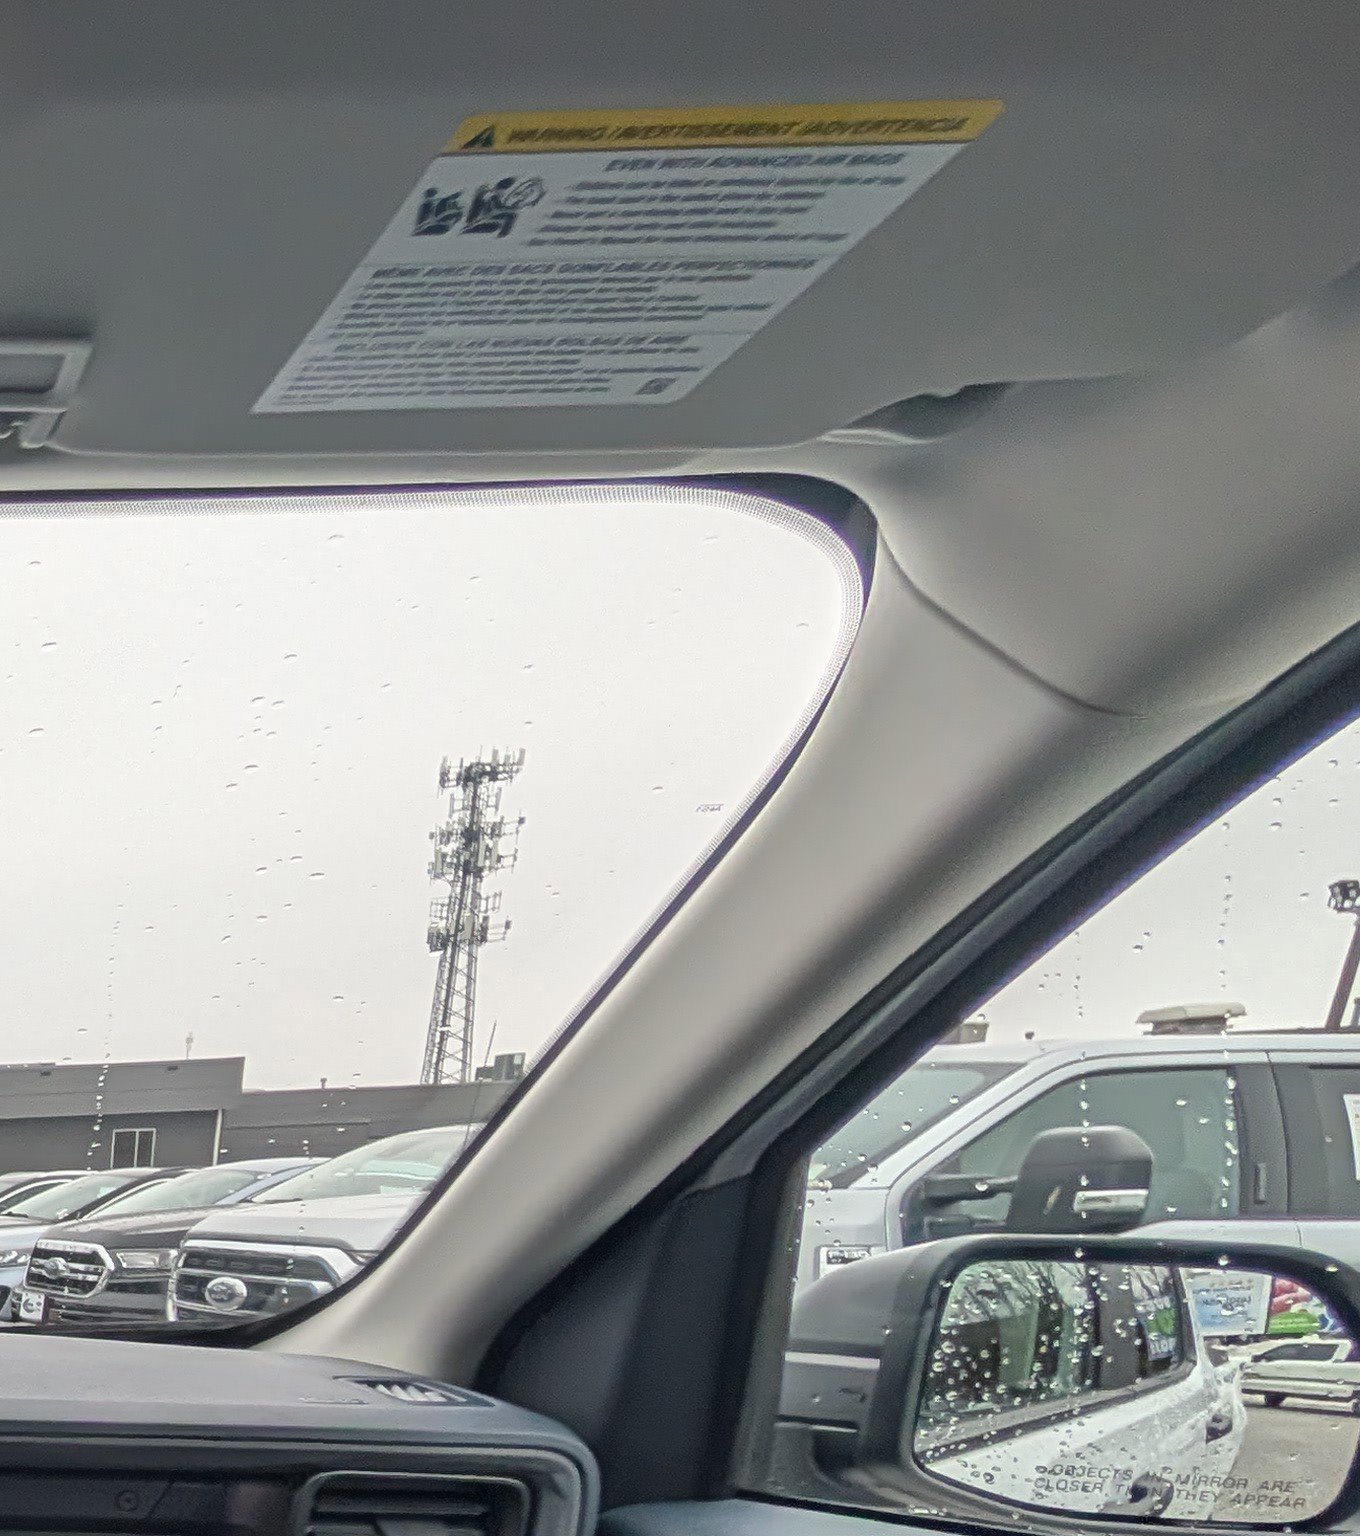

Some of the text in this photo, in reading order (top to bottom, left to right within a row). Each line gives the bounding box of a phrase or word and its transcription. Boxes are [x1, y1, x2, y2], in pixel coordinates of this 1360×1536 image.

[1034, 1478, 1103, 1493] CLOSER
[1175, 1488, 1219, 1502] THEY
[1229, 1493, 1307, 1509] APPEAR
[1175, 1473, 1248, 1490] MIRROR
[1258, 1480, 1296, 1493] ARE
